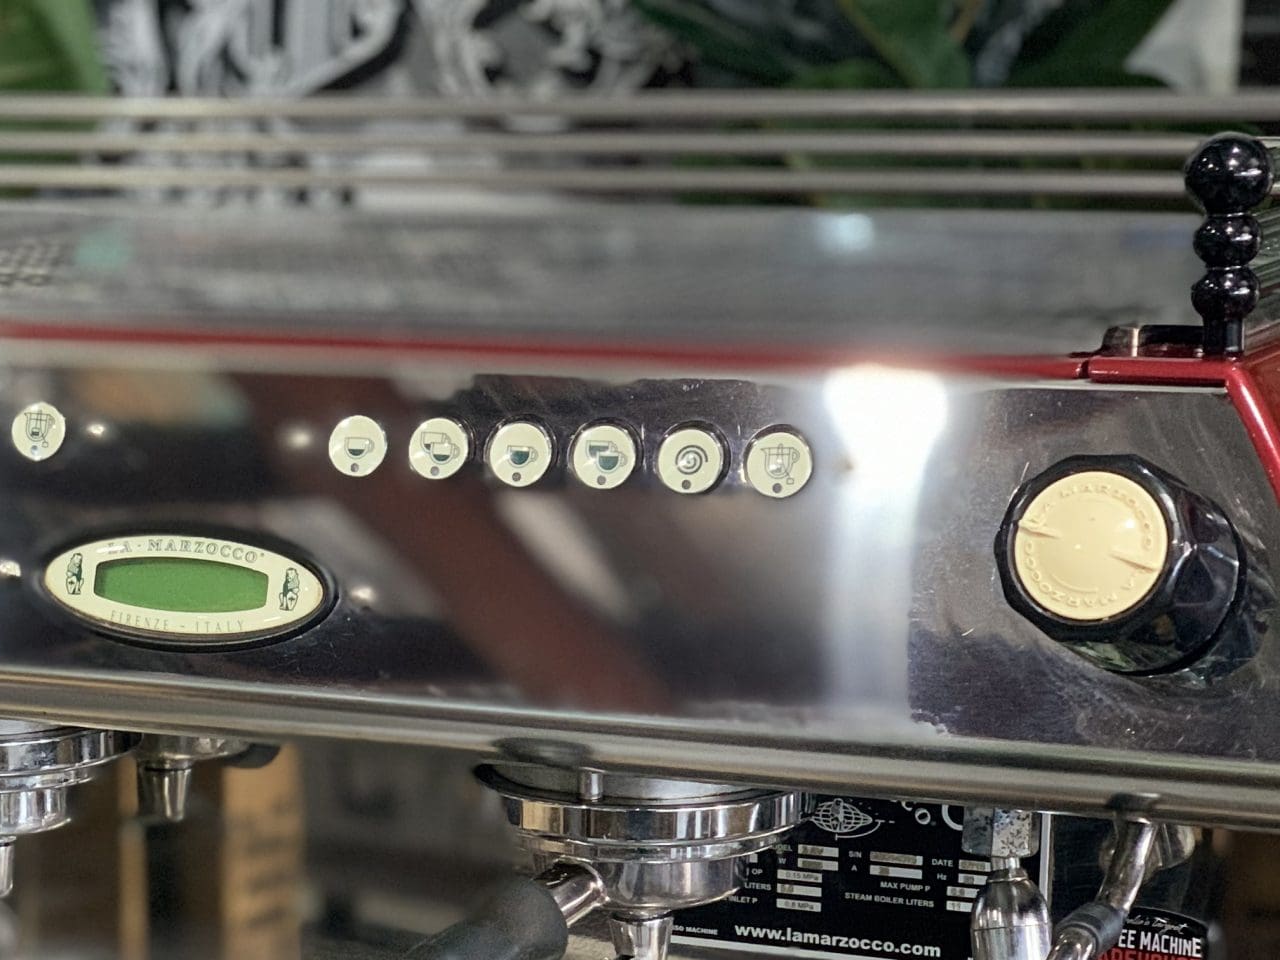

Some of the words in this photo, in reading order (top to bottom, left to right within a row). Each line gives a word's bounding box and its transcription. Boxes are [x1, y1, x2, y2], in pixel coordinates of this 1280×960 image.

[147, 538, 258, 564] MARZOCCO
[110, 610, 169, 631] FIRENZE
[195, 619, 244, 633] ITALY
[931, 858, 954, 867] DATE
[744, 881, 772, 890] LITERS
[880, 881, 898, 890] MAX
[900, 882, 924, 891] PUMP
[924, 884, 931, 892] P
[844, 891, 873, 901] STEAM
[874, 894, 904, 904] BOILER
[906, 897, 935, 908] LITERS
[685, 926, 719, 936] MACHINE
[734, 924, 942, 958] www.lamarzocco.com
[1139, 930, 1202, 958] MACHINE
